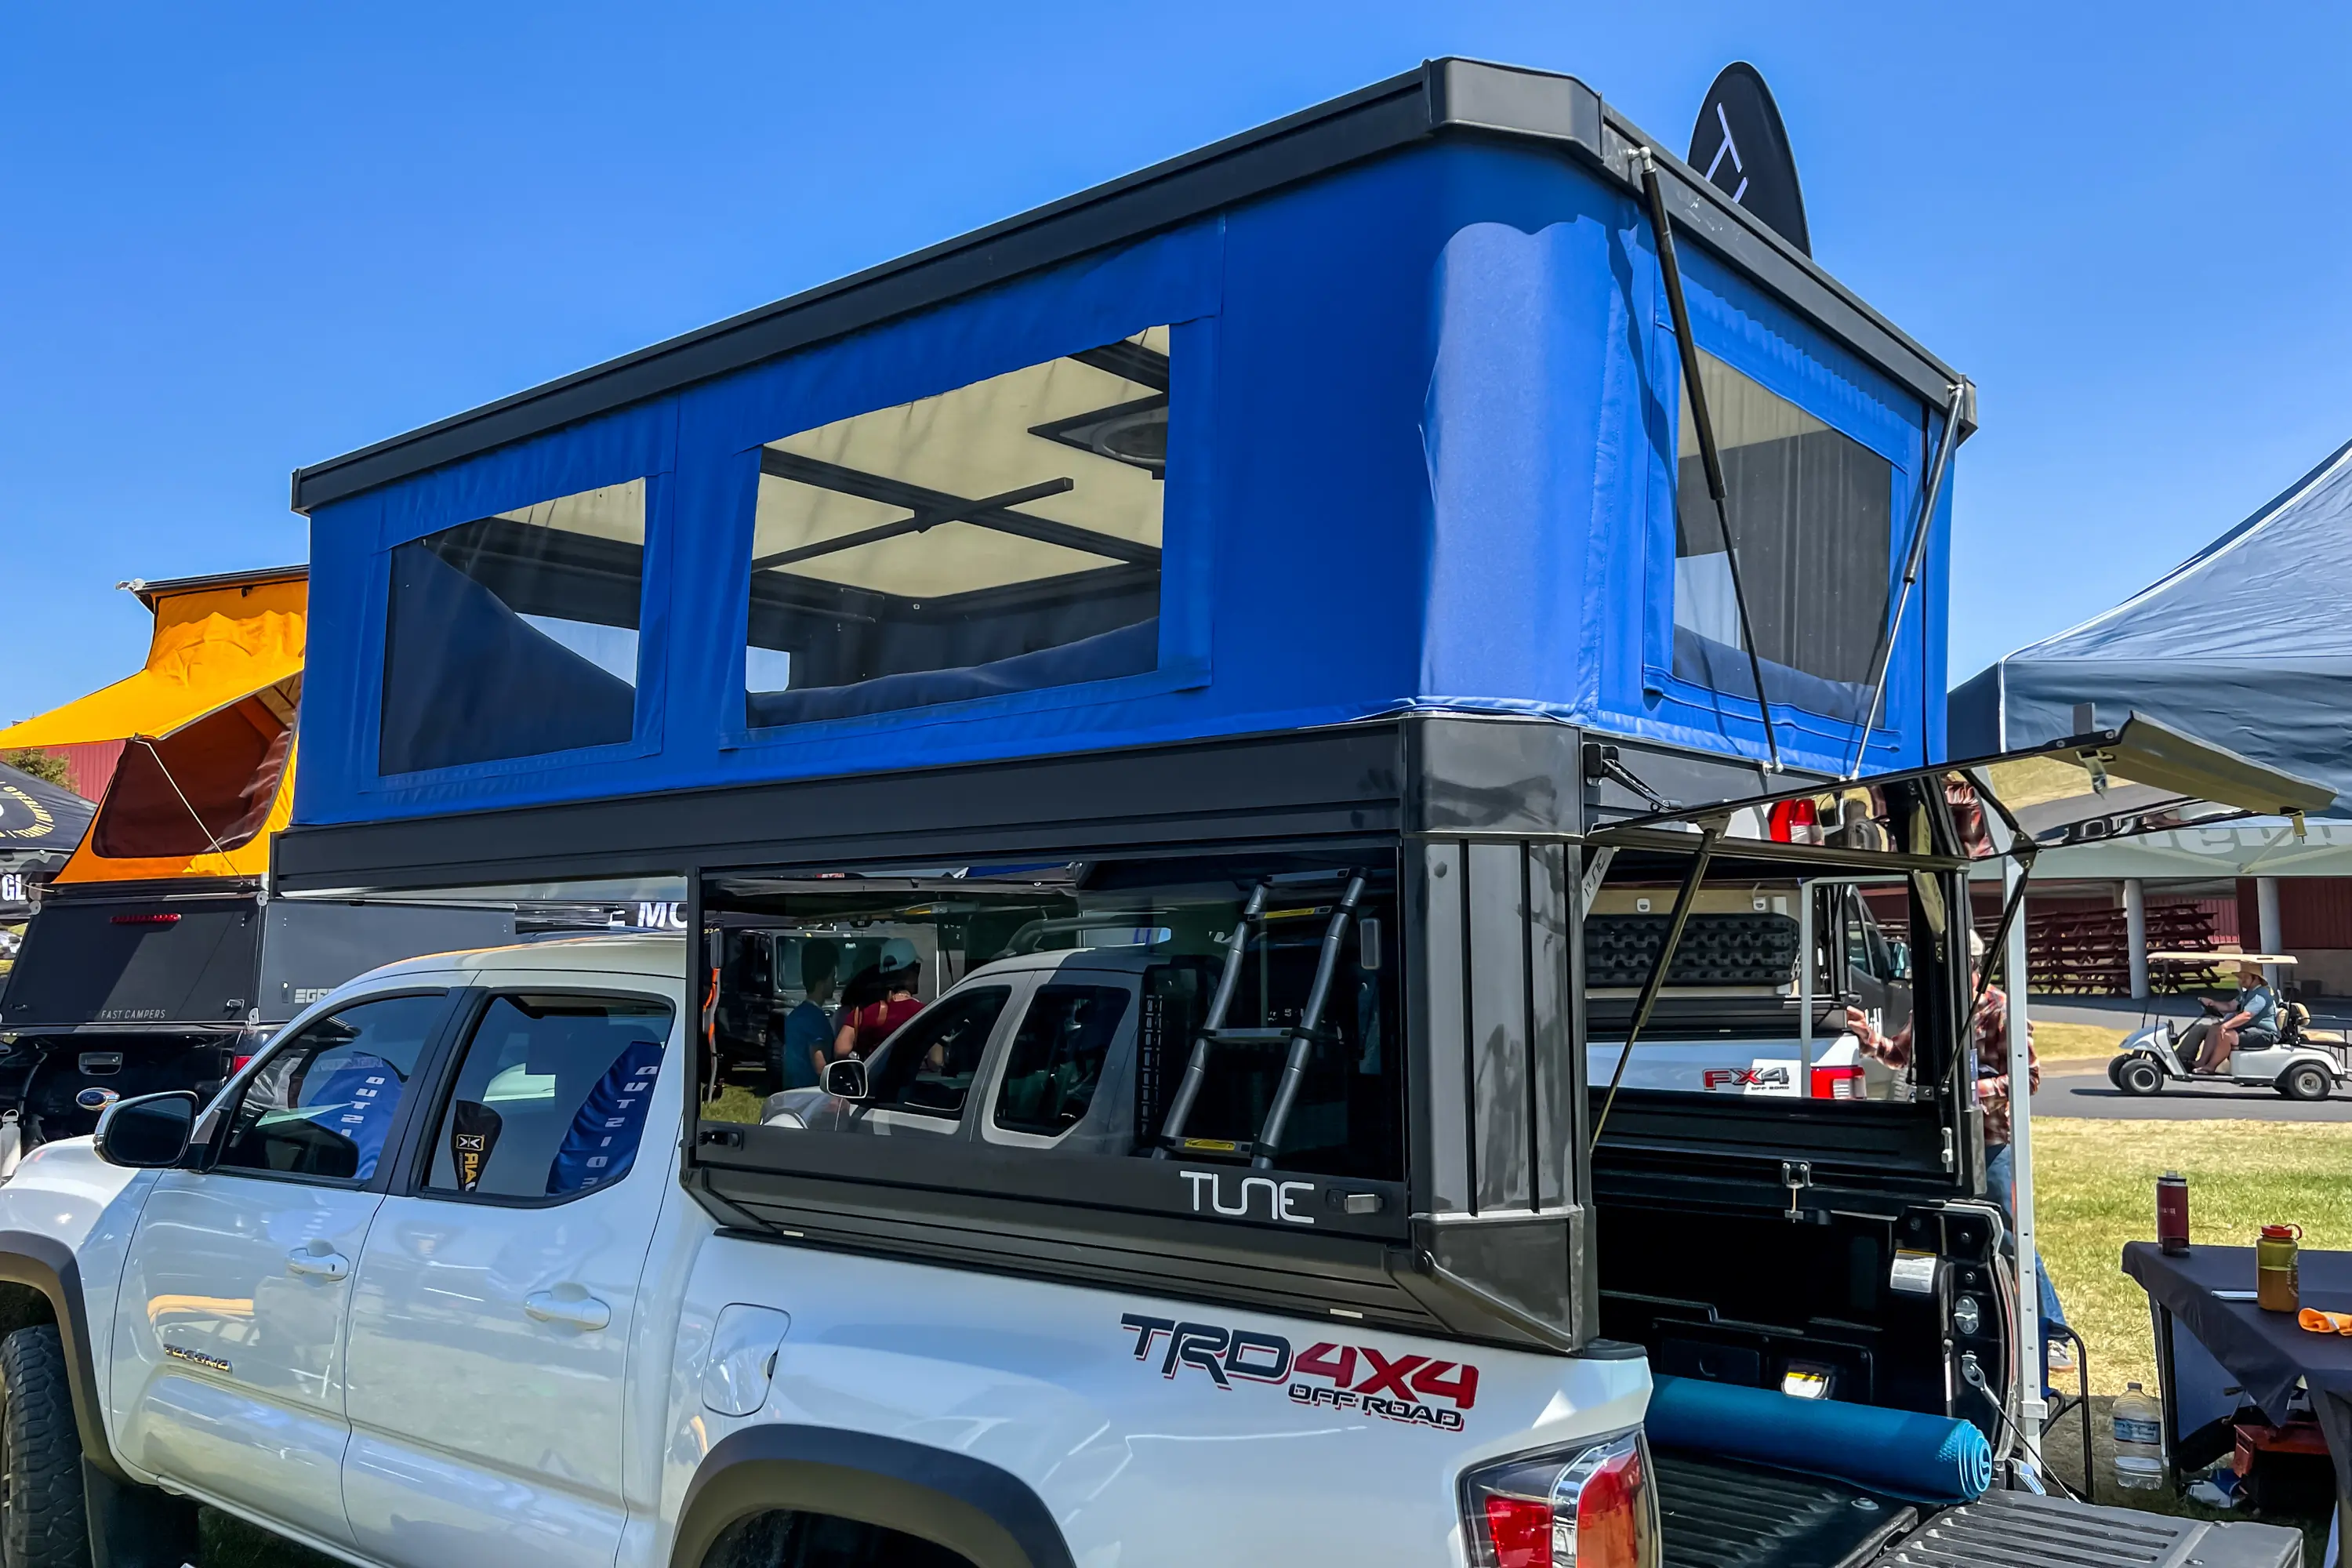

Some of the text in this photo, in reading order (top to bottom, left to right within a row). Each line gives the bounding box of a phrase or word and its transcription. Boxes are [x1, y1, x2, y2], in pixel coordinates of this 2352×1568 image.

[101, 1010, 123, 1019] FAST
[125, 1009, 166, 1019] CAMPERS
[1702, 1066, 1790, 1091] FX4
[1179, 1171, 1315, 1224] TUNE
[163, 1344, 233, 1374] TACOMA
[1120, 1312, 1294, 1391] TRD
[1287, 1382, 1465, 1432] OFF ROAD
